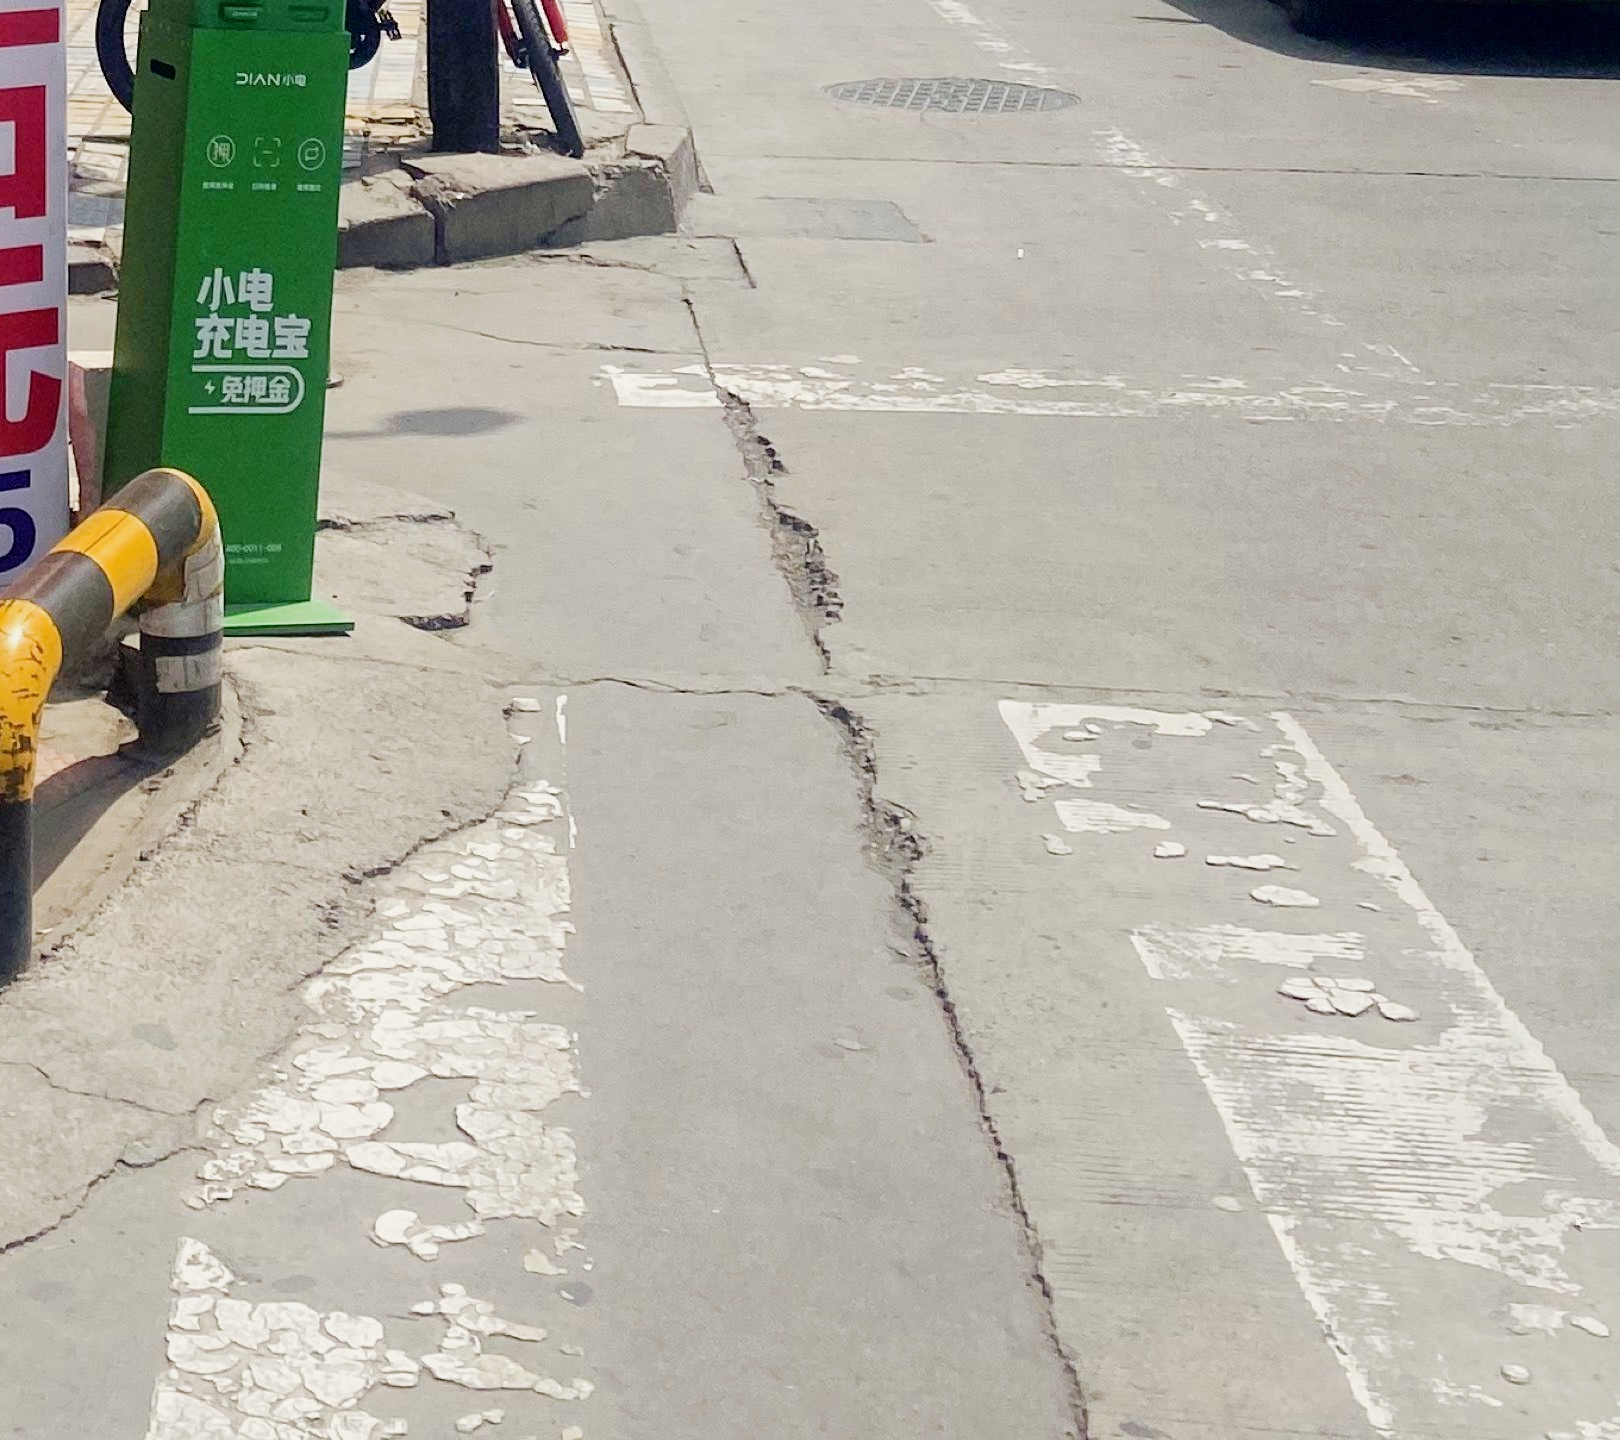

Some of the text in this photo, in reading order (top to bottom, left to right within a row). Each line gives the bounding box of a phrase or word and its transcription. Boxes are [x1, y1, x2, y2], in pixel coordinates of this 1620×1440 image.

[196, 267, 274, 312] 小电
[193, 313, 311, 359] 充电宝
[220, 375, 291, 404] 免押金
